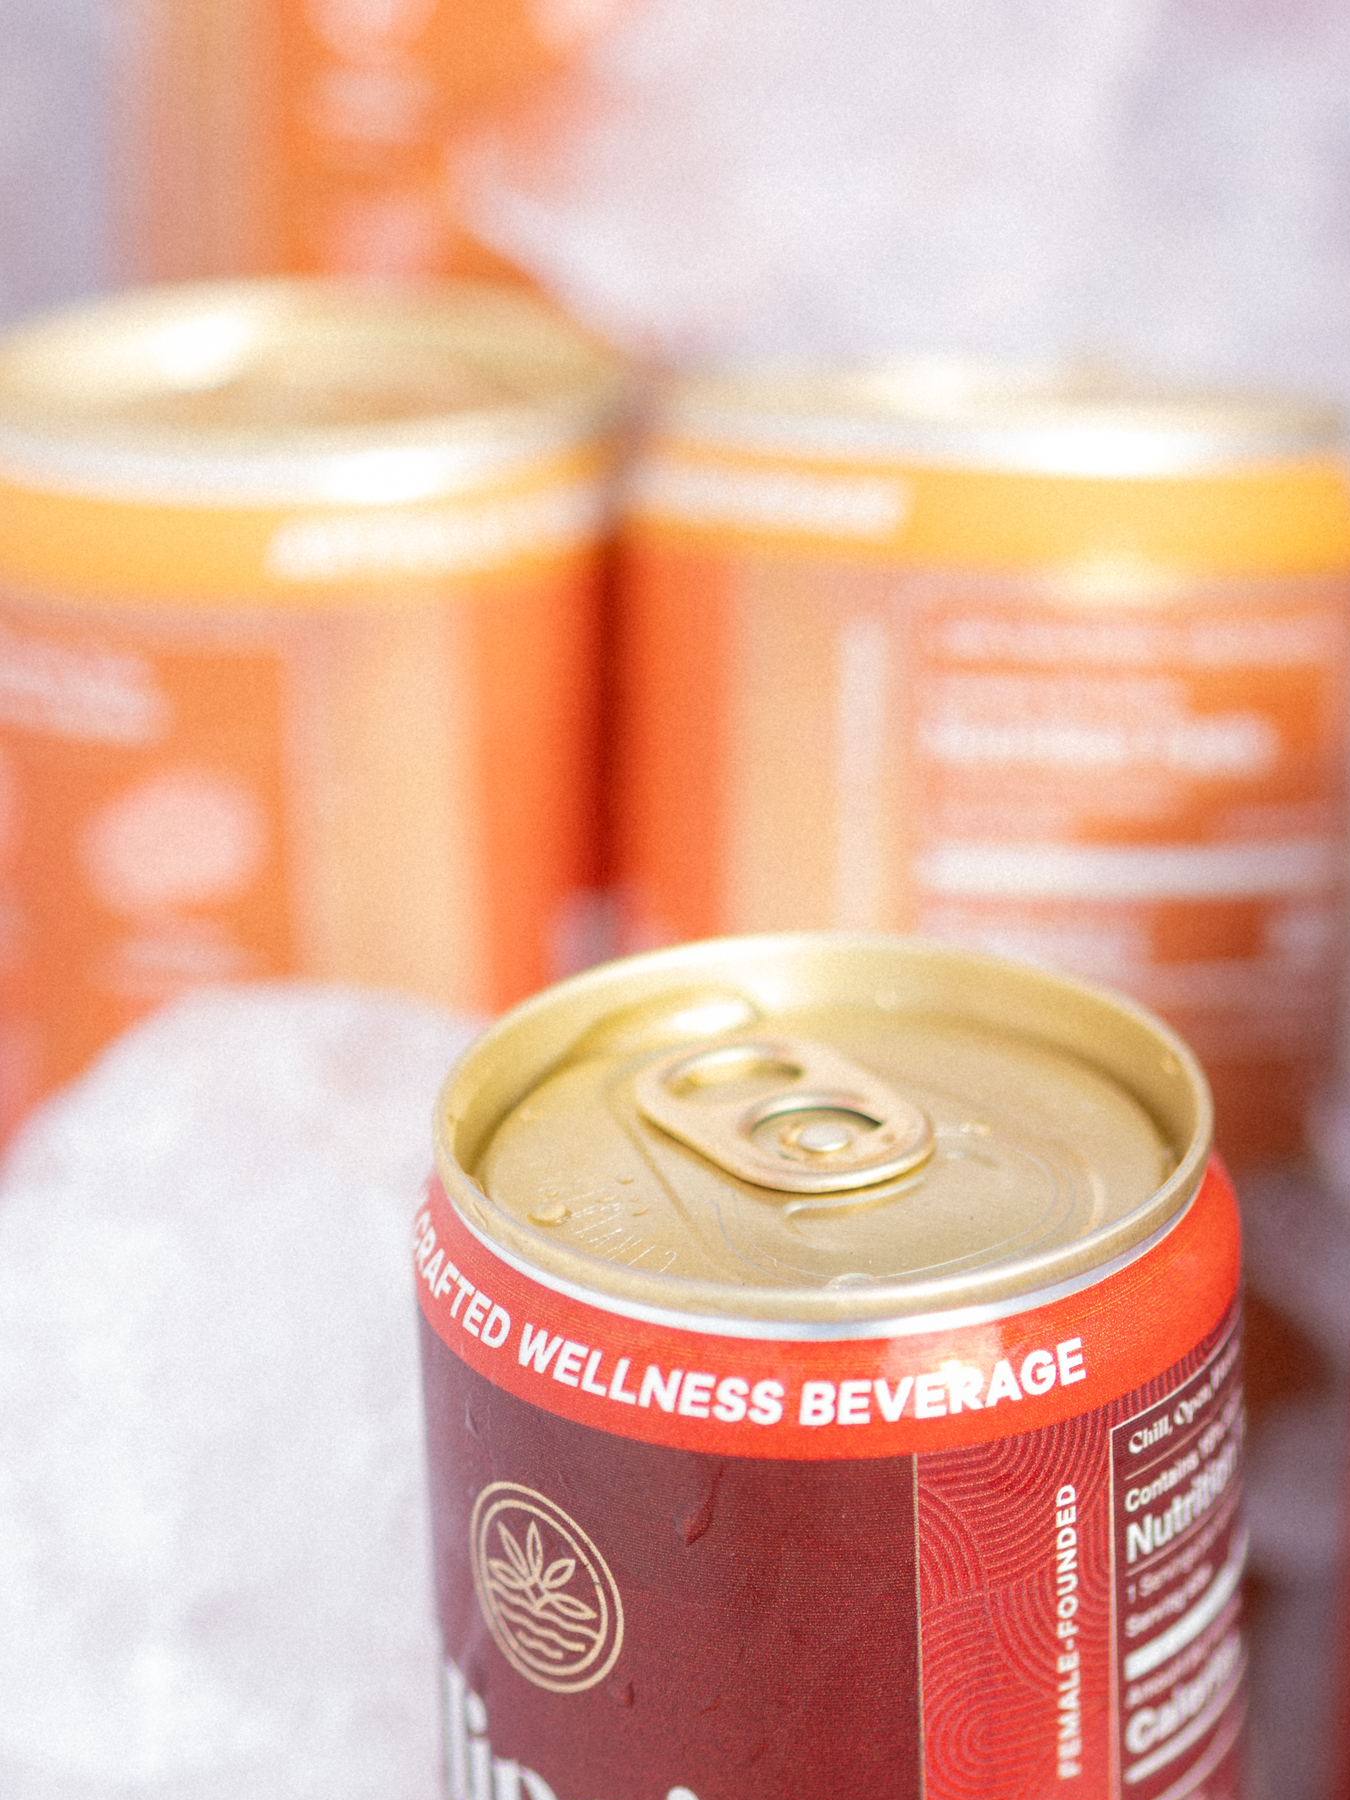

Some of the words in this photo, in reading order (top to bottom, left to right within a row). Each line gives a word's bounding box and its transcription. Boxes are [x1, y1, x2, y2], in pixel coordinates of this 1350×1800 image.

[518, 1321, 785, 1426] WELLNESS
[799, 1338, 1088, 1427] BEVERAGE
[1128, 1413, 1174, 1454] Chill,
[1124, 1449, 1200, 1512] Contains
[1056, 1483, 1082, 1782] FEMALE-FOUNDED
